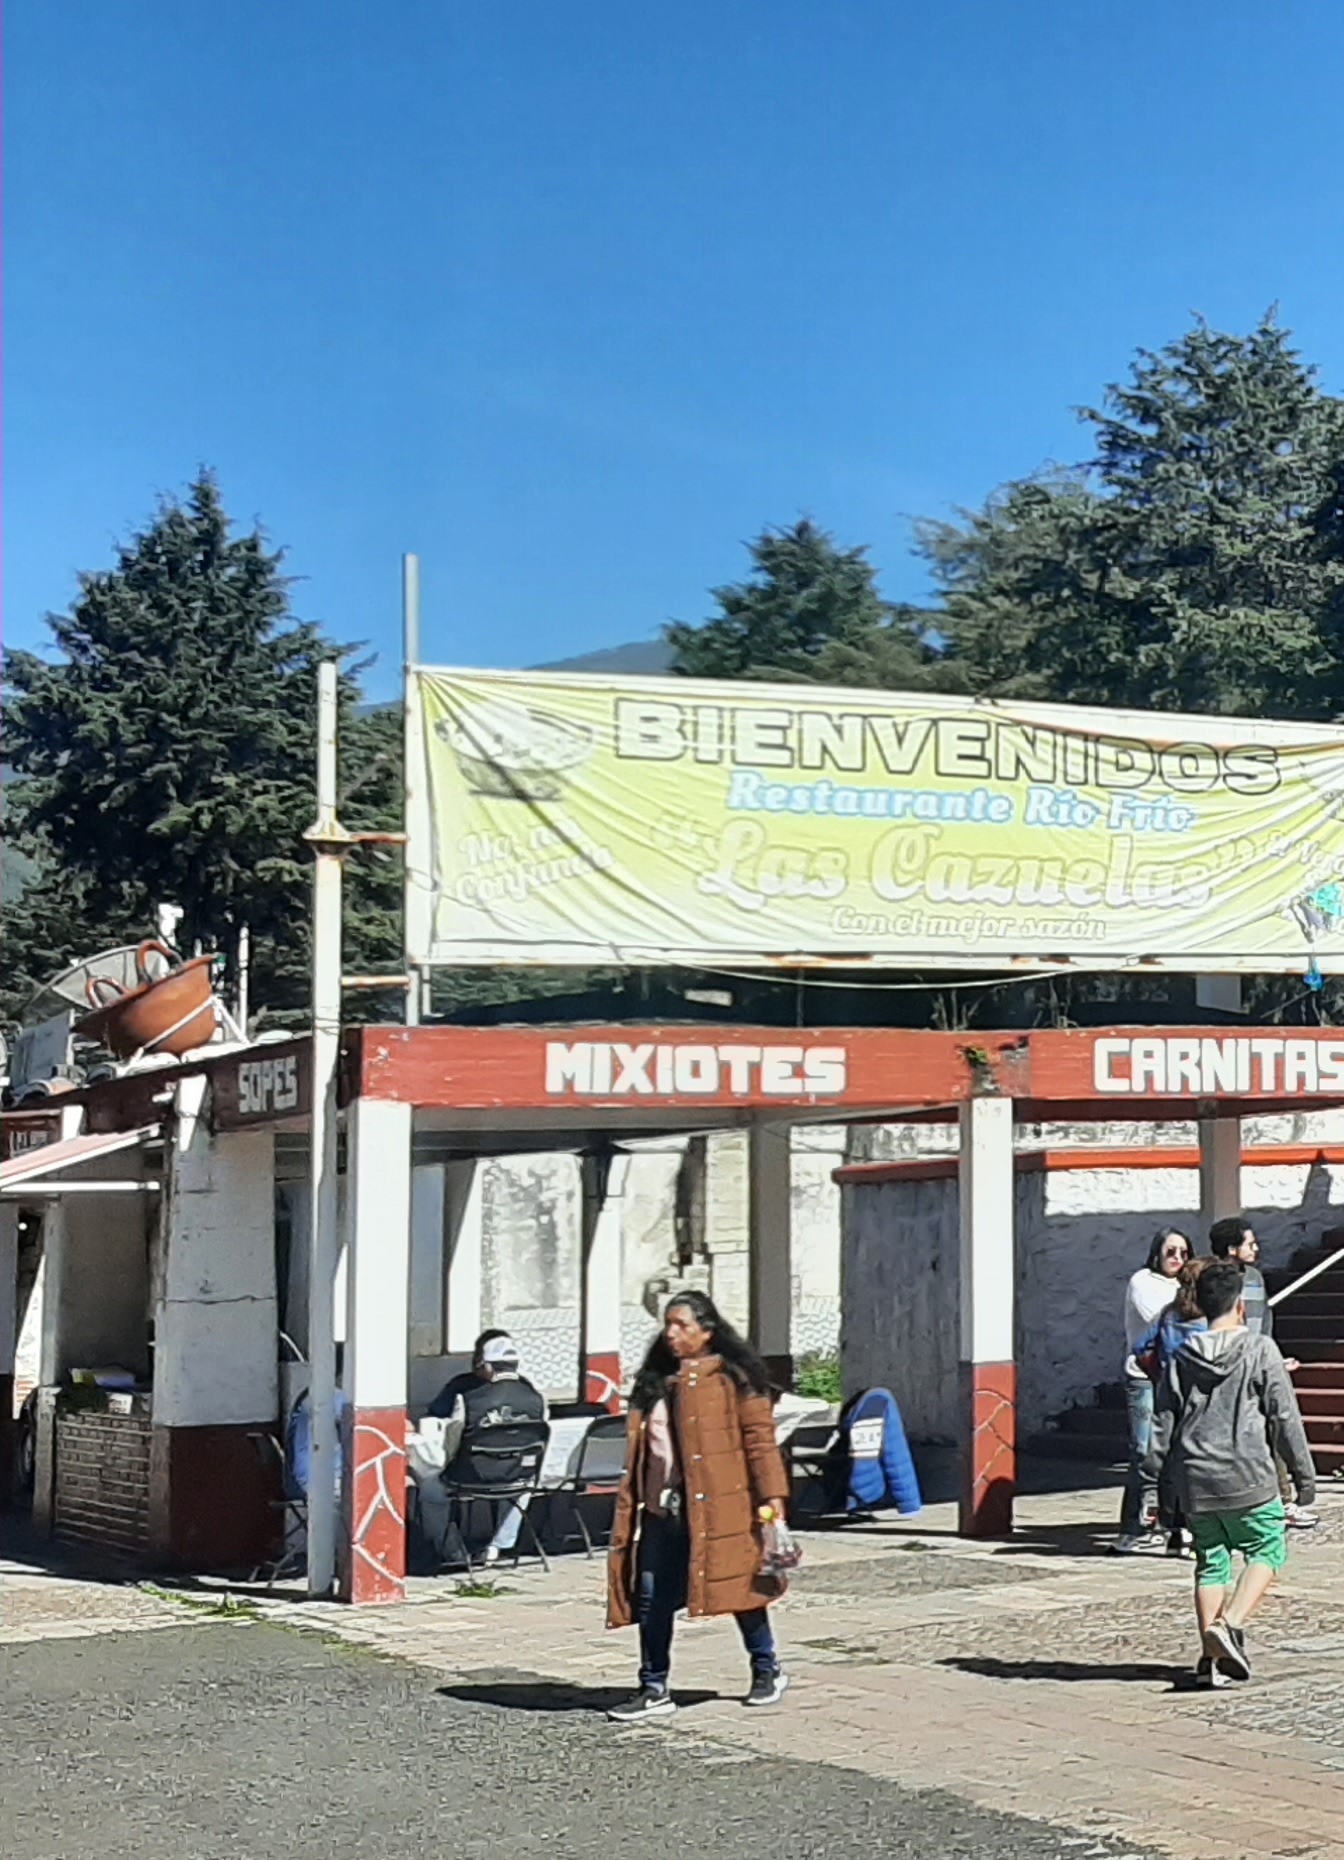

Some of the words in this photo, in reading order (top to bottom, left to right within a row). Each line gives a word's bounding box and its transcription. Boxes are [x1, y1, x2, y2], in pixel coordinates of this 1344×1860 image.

[613, 696, 1282, 796] BIENVENIDOS
[726, 767, 1013, 823] Restaurante
[831, 903, 890, 935] Con
[926, 909, 1016, 944] mejor
[1019, 911, 1107, 941] sazón
[237, 1054, 300, 1114] SOPES
[545, 1041, 847, 1096] MIXIOTES
